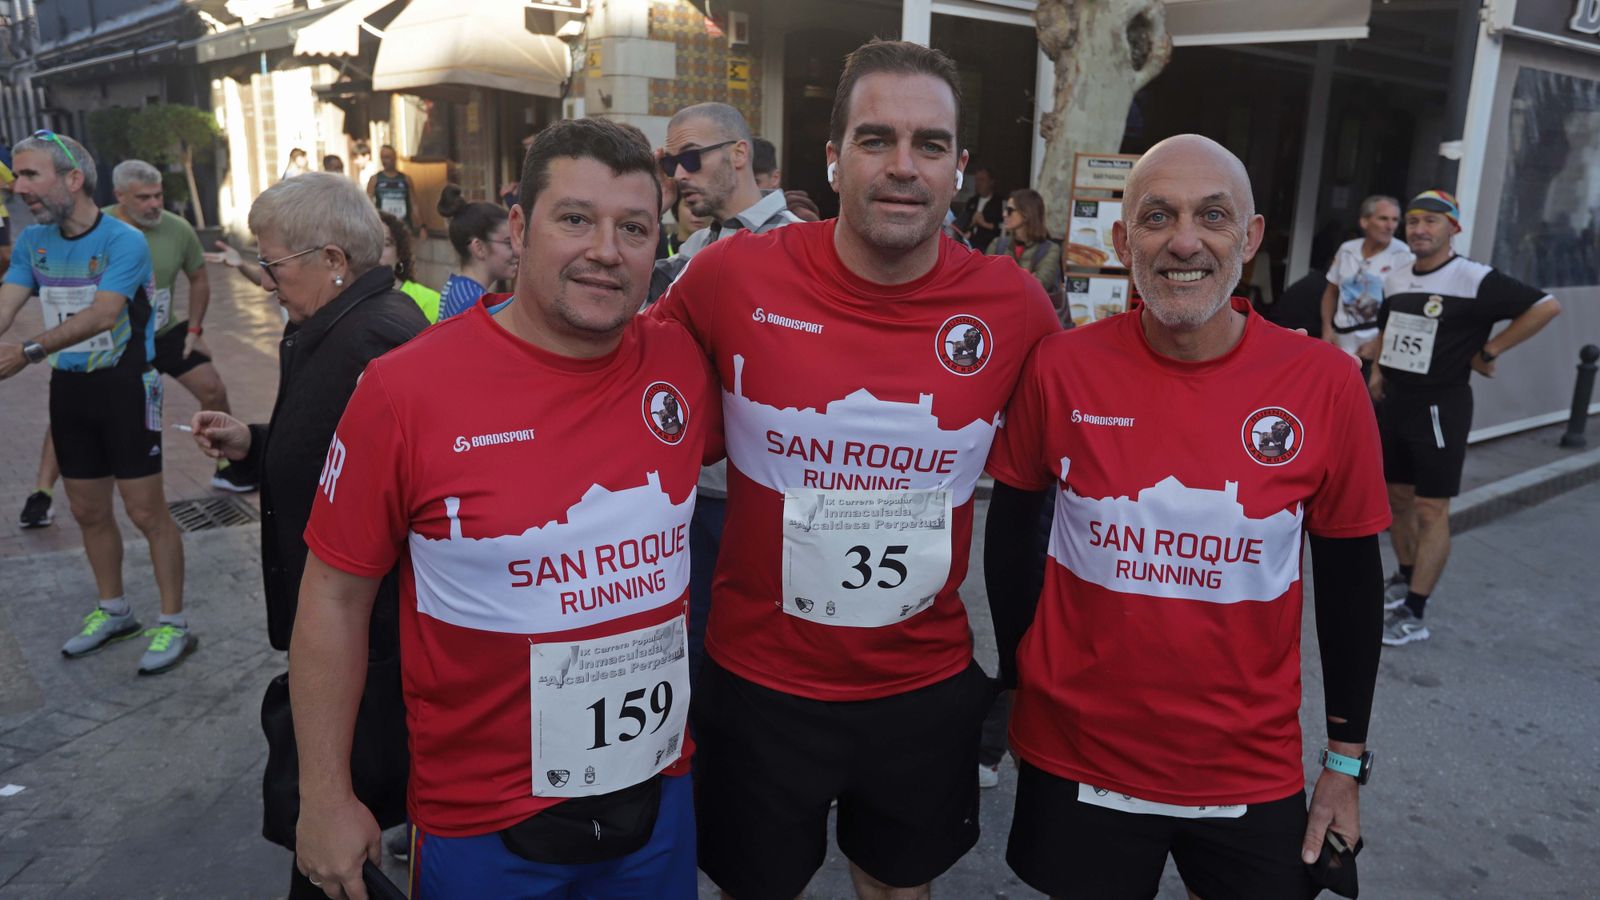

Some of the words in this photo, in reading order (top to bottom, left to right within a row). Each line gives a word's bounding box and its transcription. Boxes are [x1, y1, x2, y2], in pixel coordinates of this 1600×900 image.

[767, 312, 824, 334] BORDISPORT
[1392, 334, 1423, 356] 155
[1083, 413, 1136, 428] BORDISPORT
[471, 428, 535, 448] BORDISPORT
[766, 429, 834, 465] SAN
[843, 440, 958, 474] ROQUE
[803, 468, 912, 491] RUNNING
[824, 506, 912, 519] Inmaculada
[507, 549, 588, 588] SAN
[594, 523, 687, 576] ROQUE
[1089, 520, 1146, 554] SAN
[1154, 529, 1264, 566] ROQUE
[841, 544, 909, 590] 35
[1115, 559, 1223, 590] RUNNING
[560, 568, 667, 615] RUNNING
[579, 644, 664, 671] Inmaculada
[585, 680, 674, 751] 159
